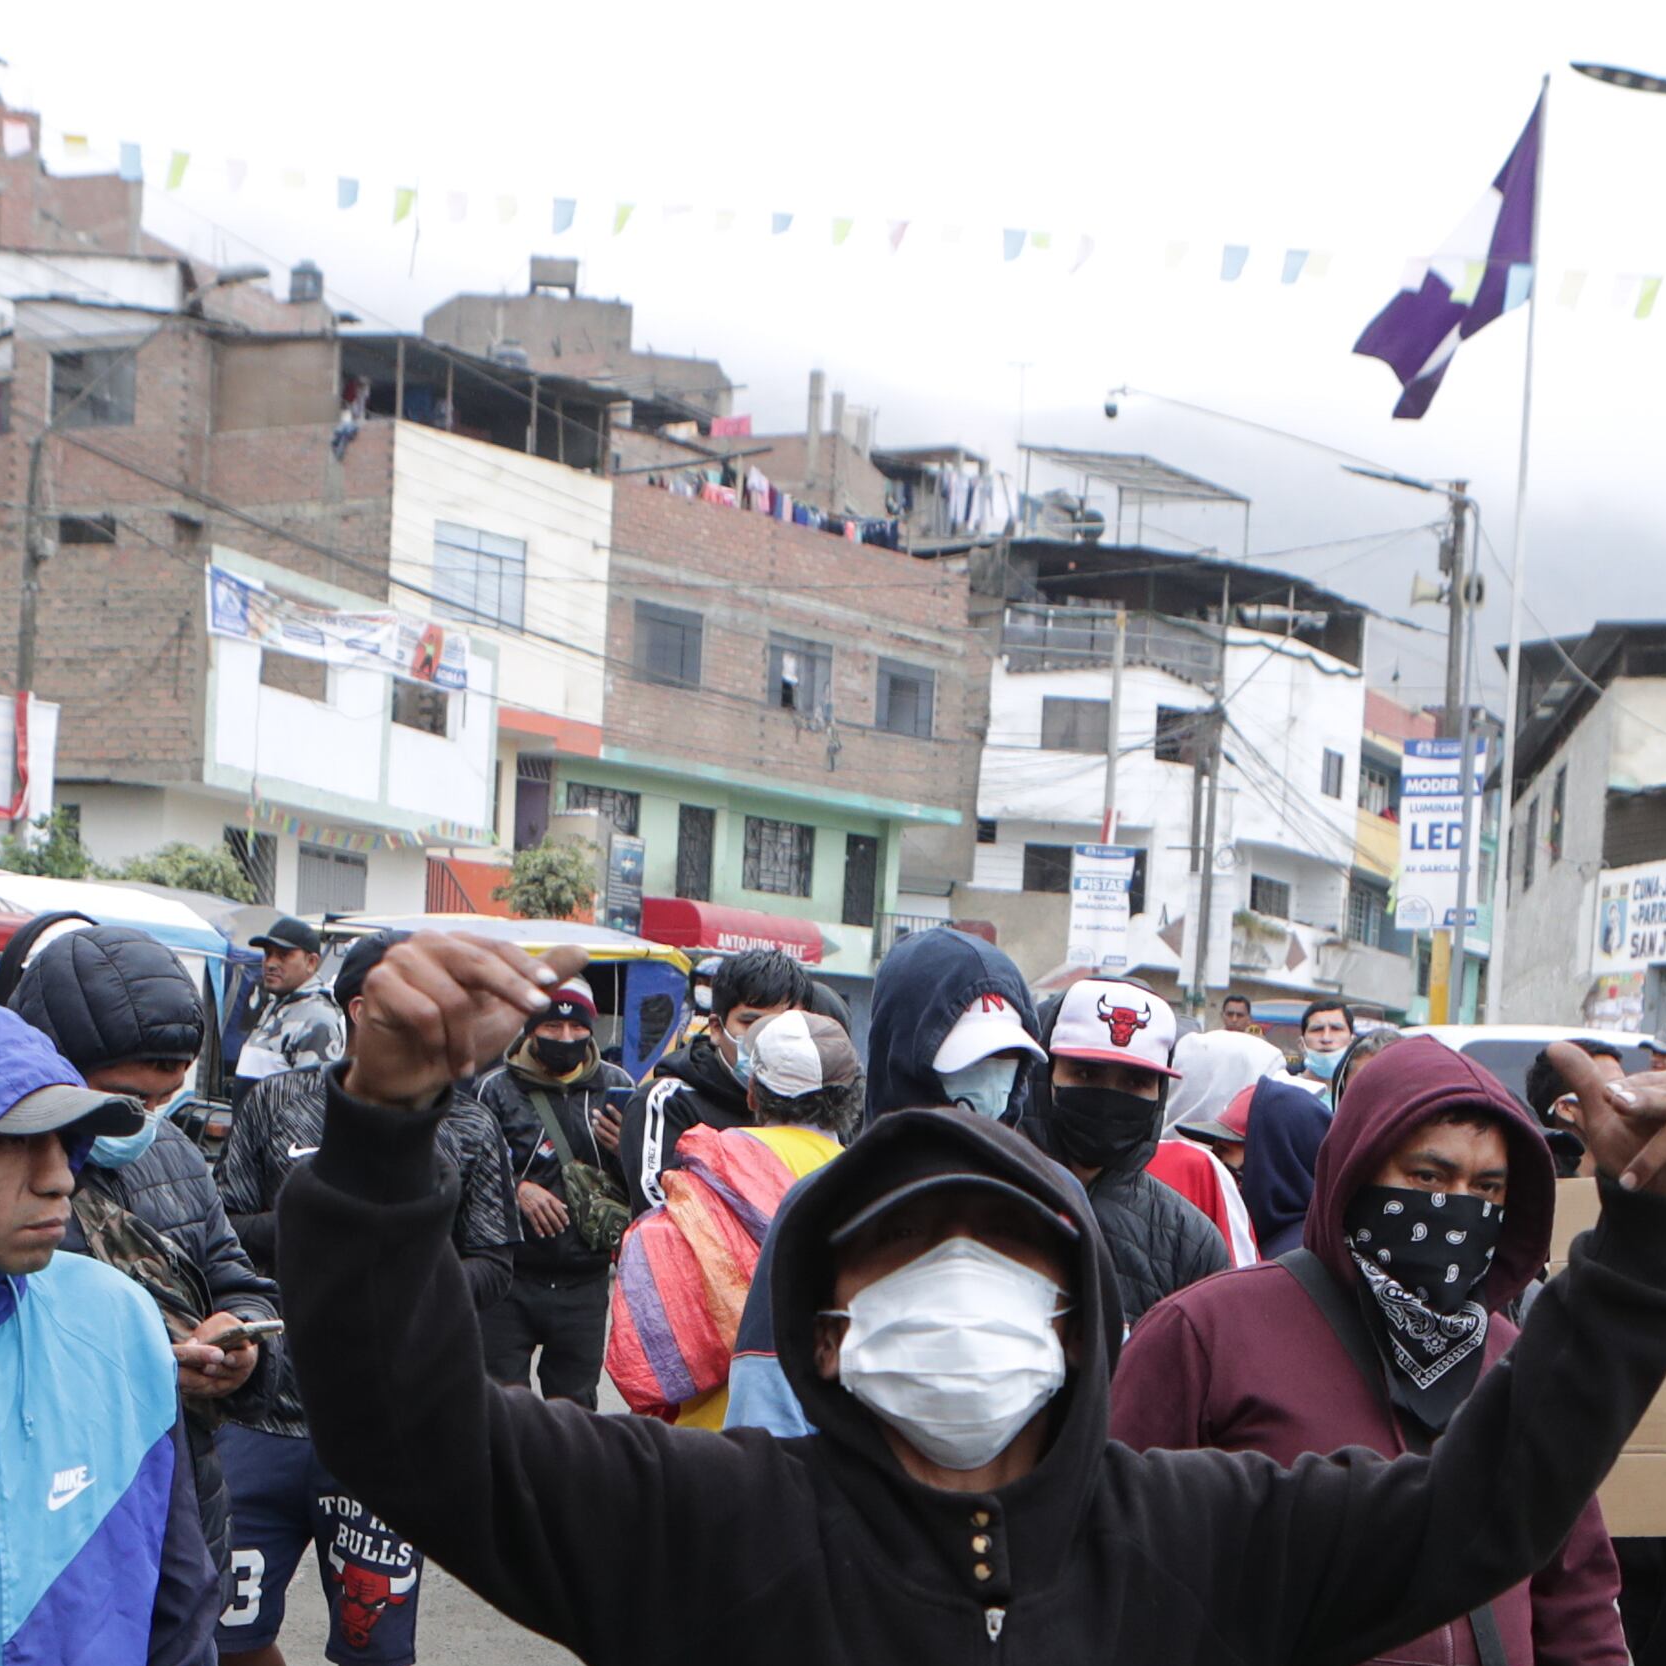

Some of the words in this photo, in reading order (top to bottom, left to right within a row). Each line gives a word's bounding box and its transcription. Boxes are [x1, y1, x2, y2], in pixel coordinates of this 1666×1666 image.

[1405, 778, 1480, 793] MODERA
[1410, 822, 1463, 850] LED
[1080, 878, 1125, 890] PISTAS
[1631, 932, 1657, 958] SAN
[53, 1465, 88, 1493] NIKE
[318, 1496, 363, 1521] TOP
[336, 1522, 413, 1567] BULLS
